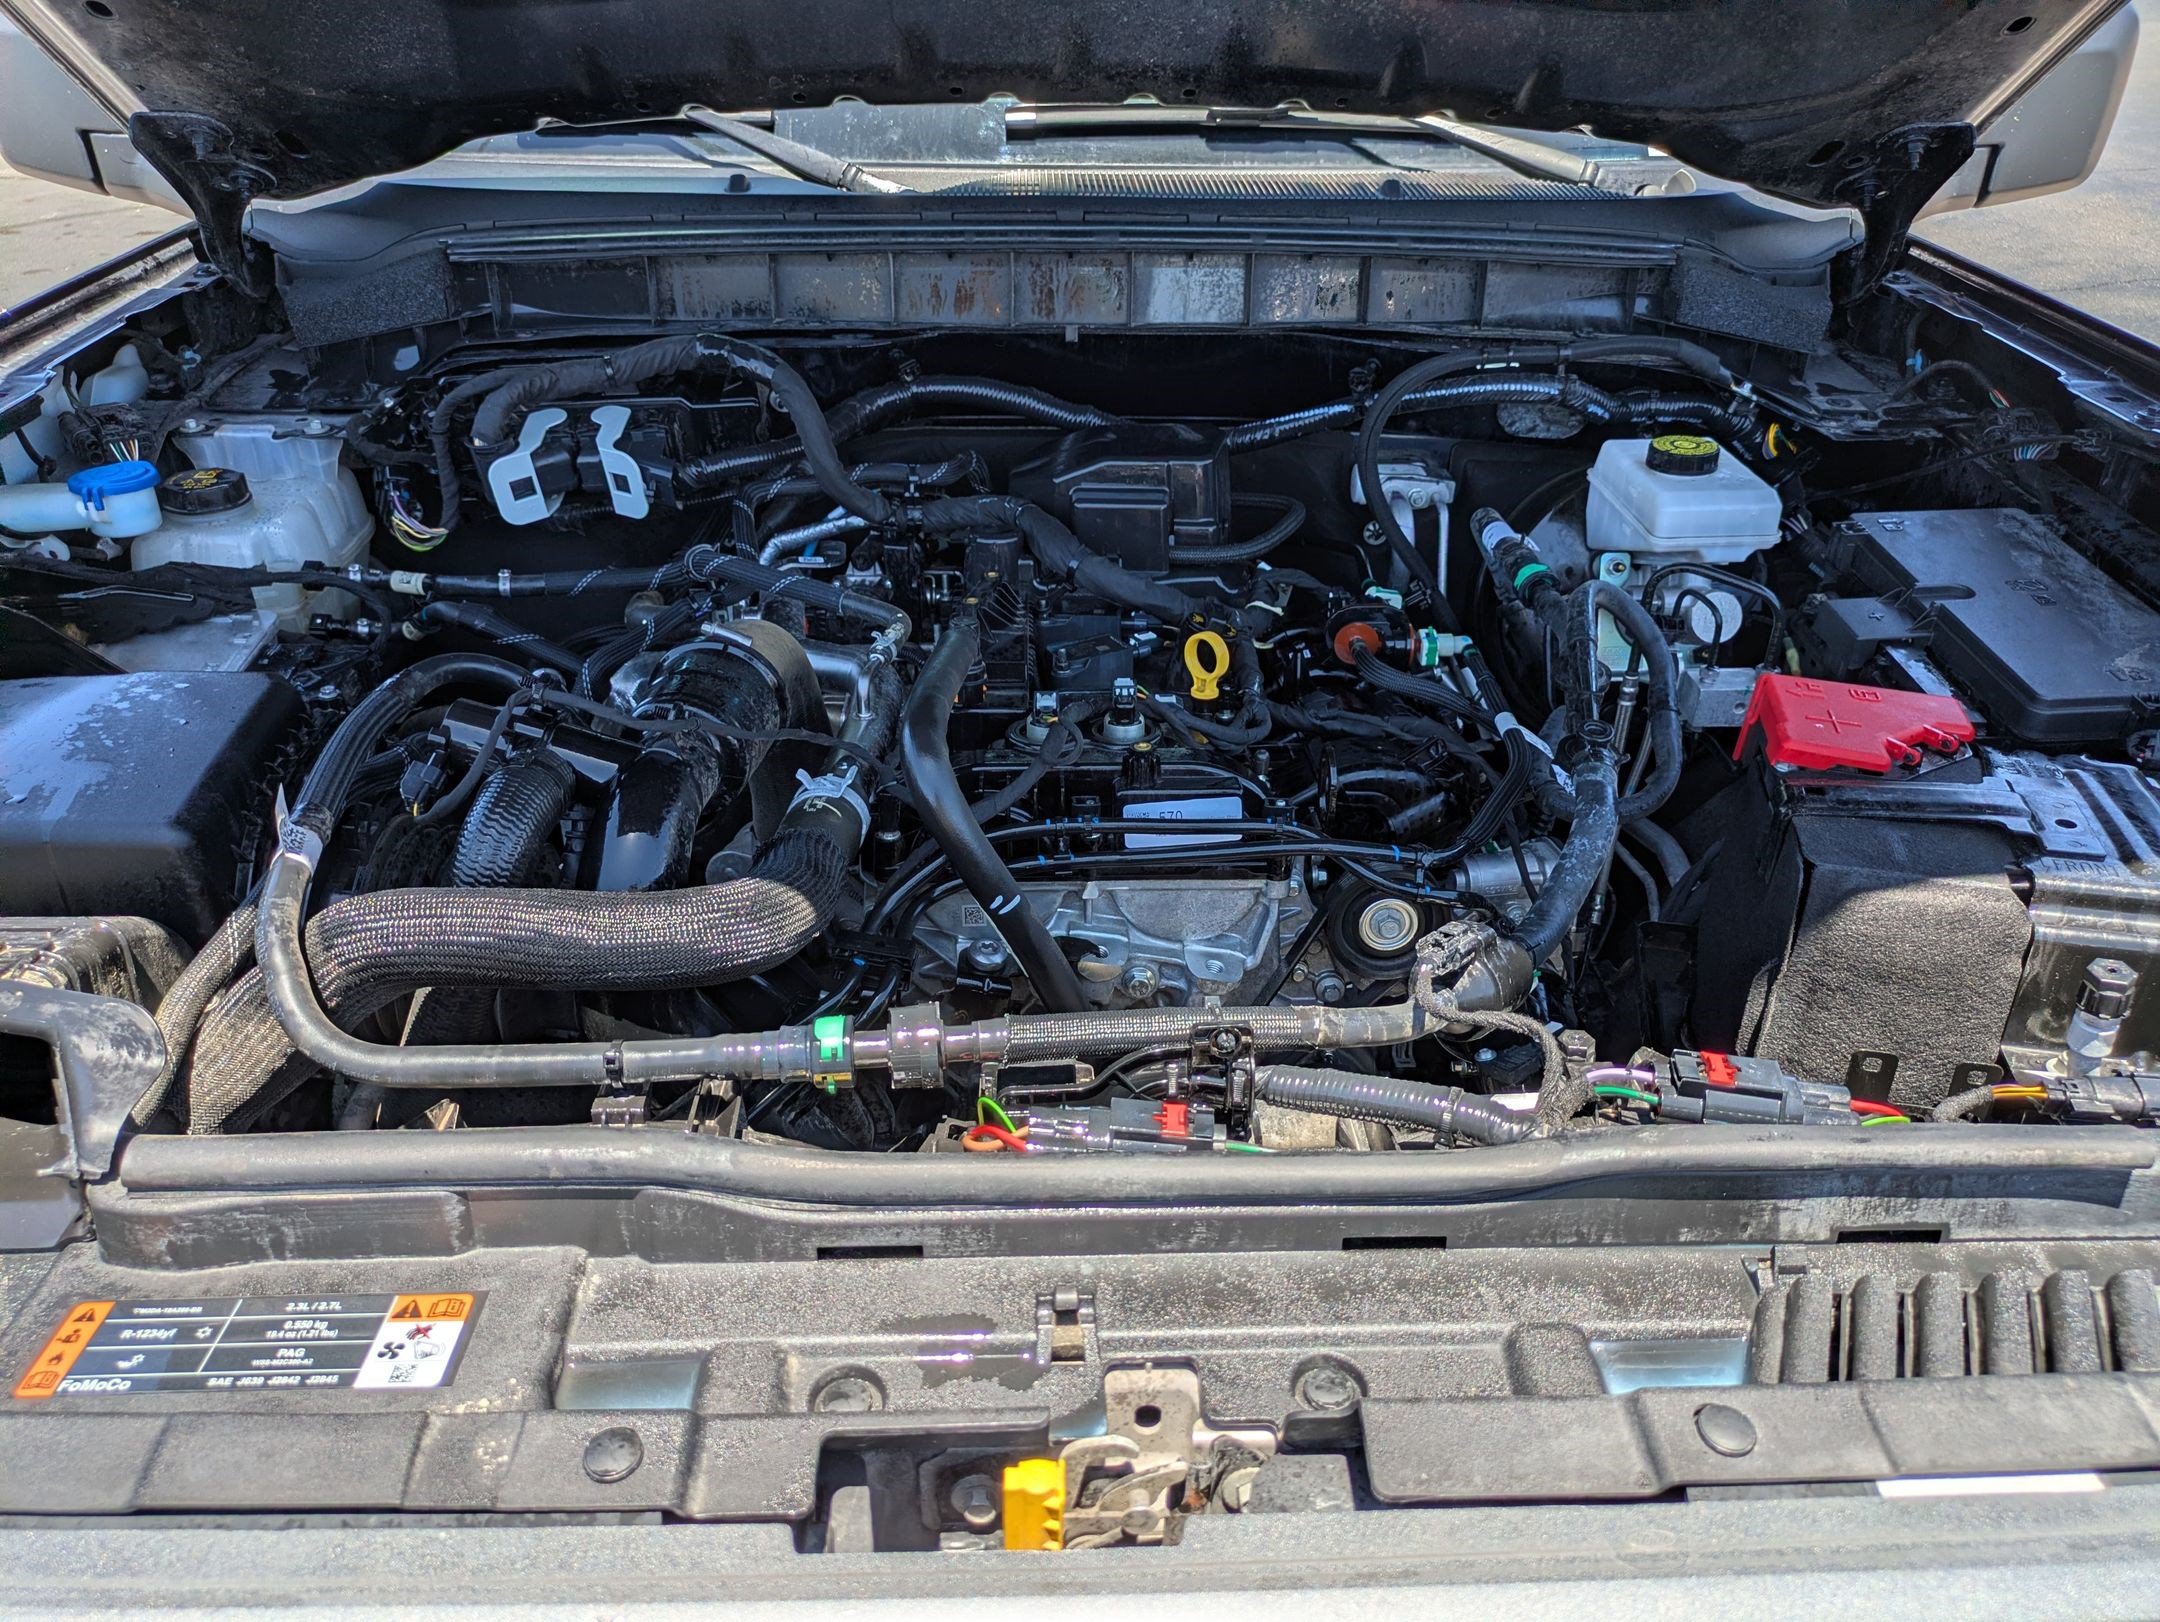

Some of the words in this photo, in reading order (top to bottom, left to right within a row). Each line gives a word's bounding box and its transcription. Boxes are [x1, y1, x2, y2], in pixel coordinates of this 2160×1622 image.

[283, 1320, 314, 1331] 0.550
[314, 1319, 329, 1331] kg
[119, 1327, 179, 1340] R-1234yf
[276, 1347, 306, 1359] PAG
[57, 1377, 132, 1393] FoMoCo
[206, 1376, 234, 1388] SAE
